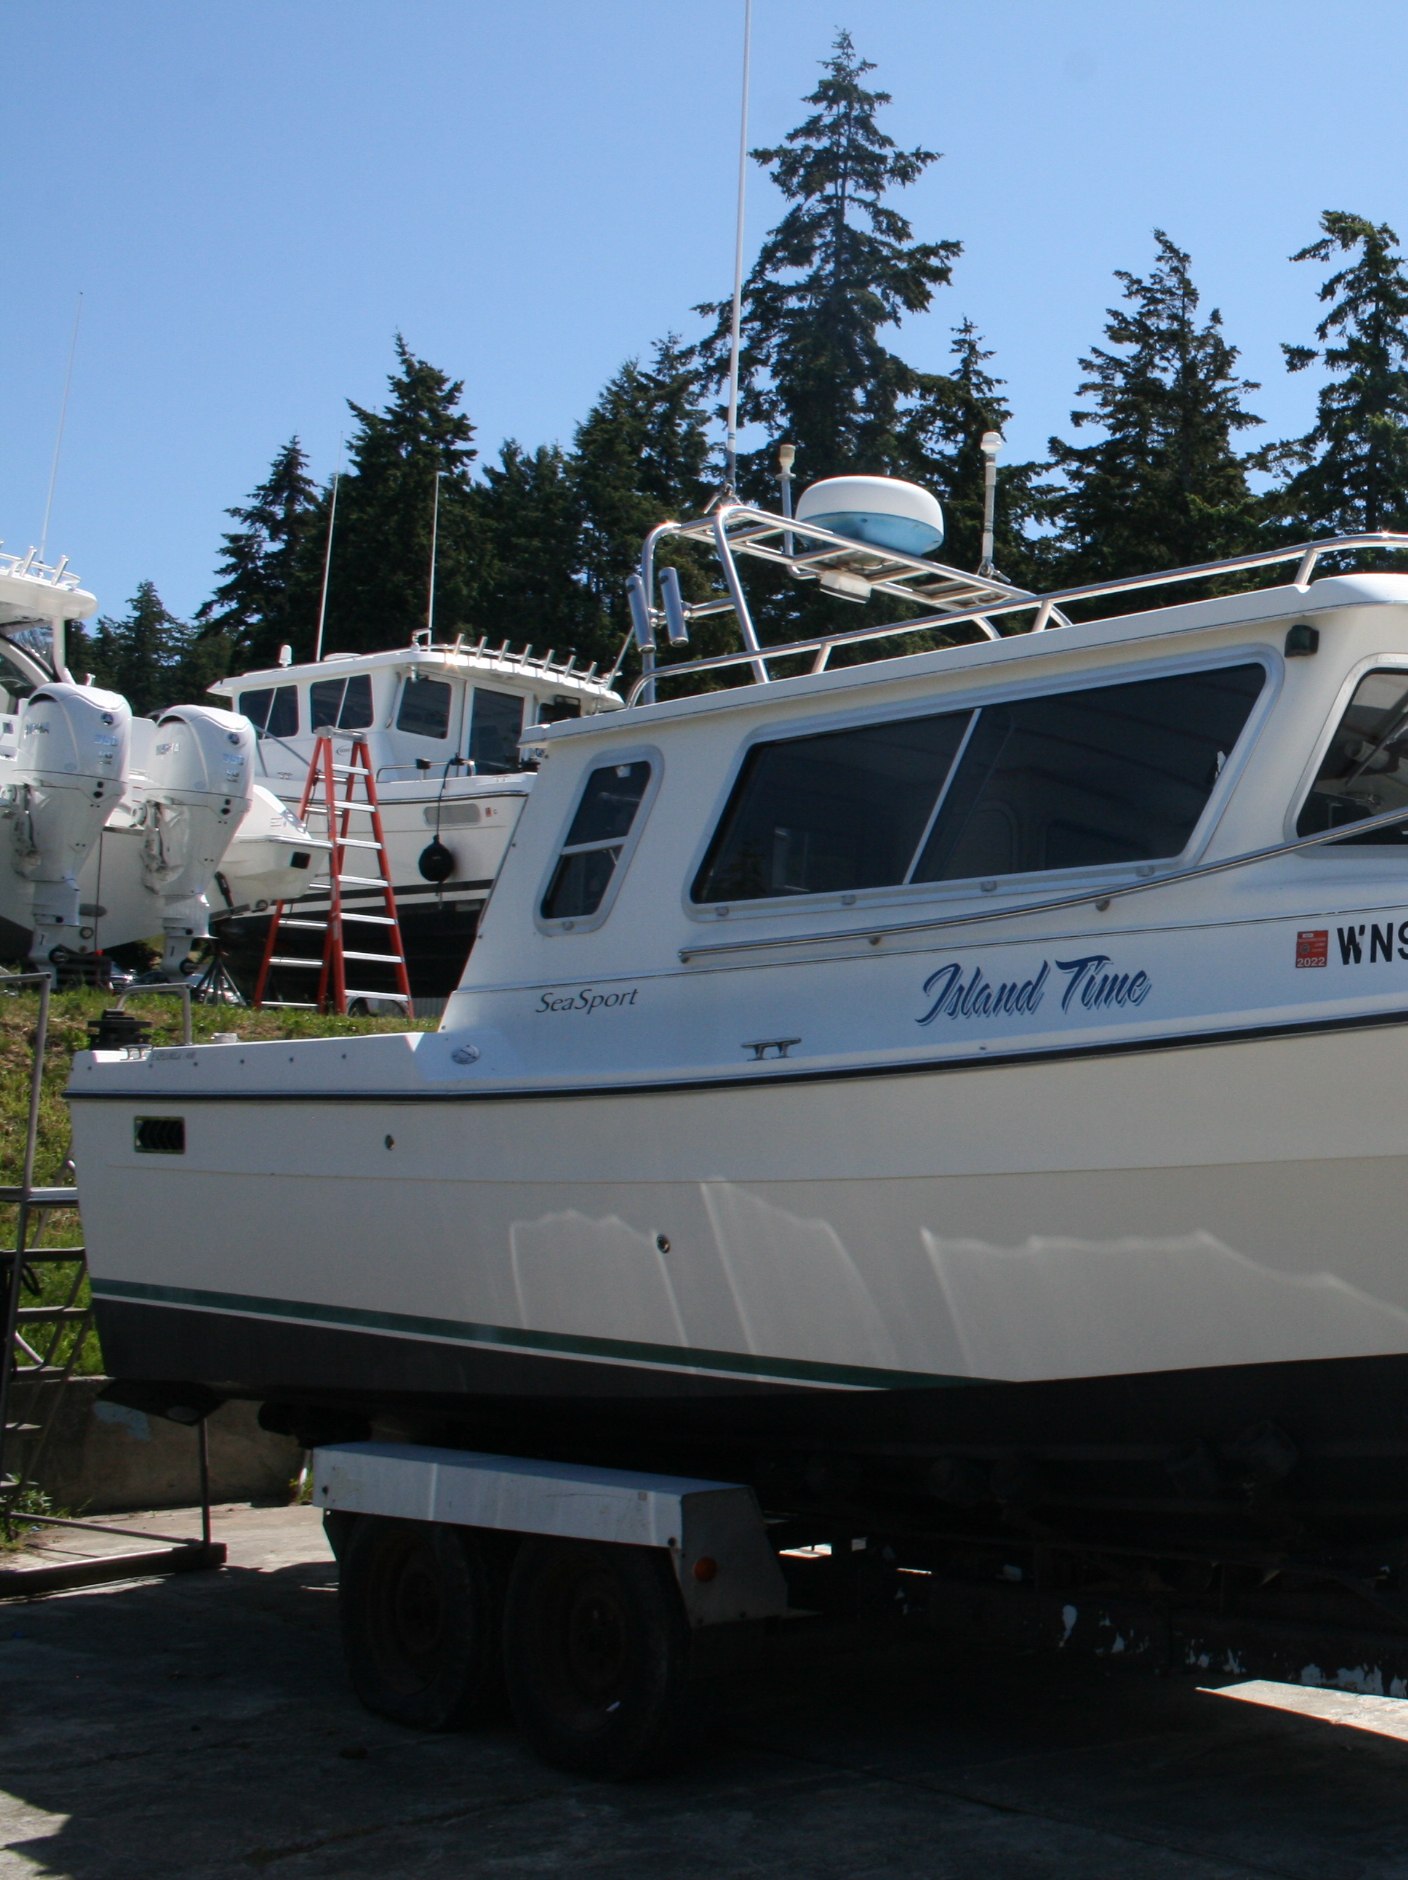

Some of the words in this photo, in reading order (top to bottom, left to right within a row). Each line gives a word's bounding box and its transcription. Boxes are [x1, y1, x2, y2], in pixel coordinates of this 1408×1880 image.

[1296, 956, 1325, 967] 2022
[535, 988, 639, 1015] SeaSport
[914, 960, 1051, 1027] Island
[1055, 954, 1152, 1015] Time
